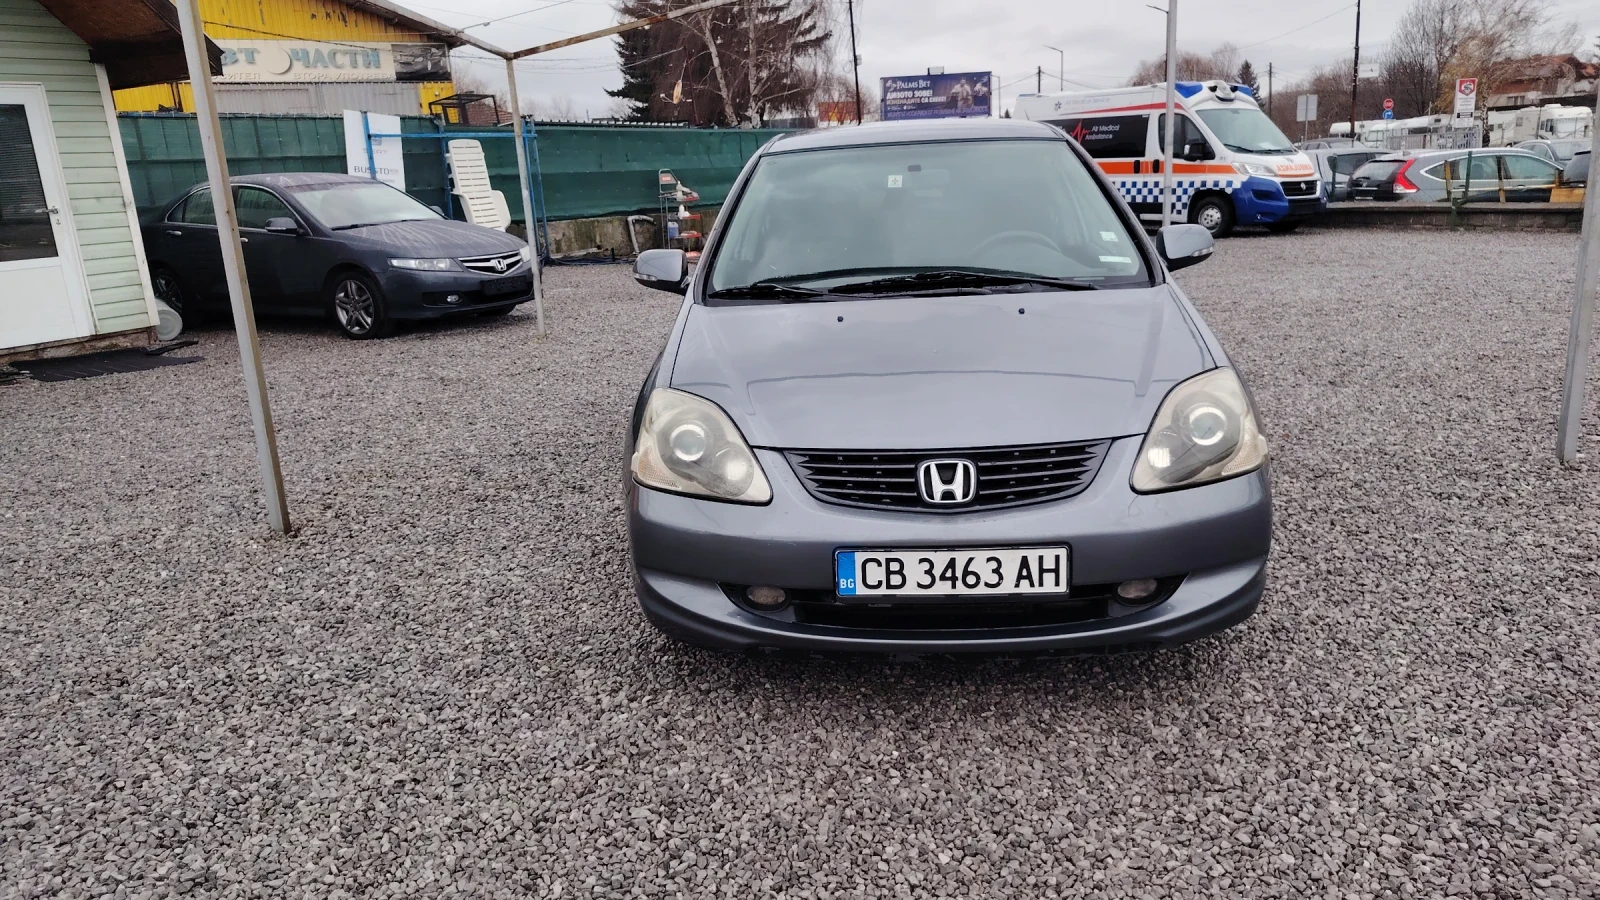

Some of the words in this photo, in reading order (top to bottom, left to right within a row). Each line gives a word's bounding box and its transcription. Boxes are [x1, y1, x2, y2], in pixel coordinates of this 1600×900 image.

[289, 47, 381, 69] ЧАСТИ
[840, 578, 855, 589] BG
[861, 557, 907, 590] CB
[916, 556, 1004, 590] 3463
[1014, 554, 1061, 589] AH
